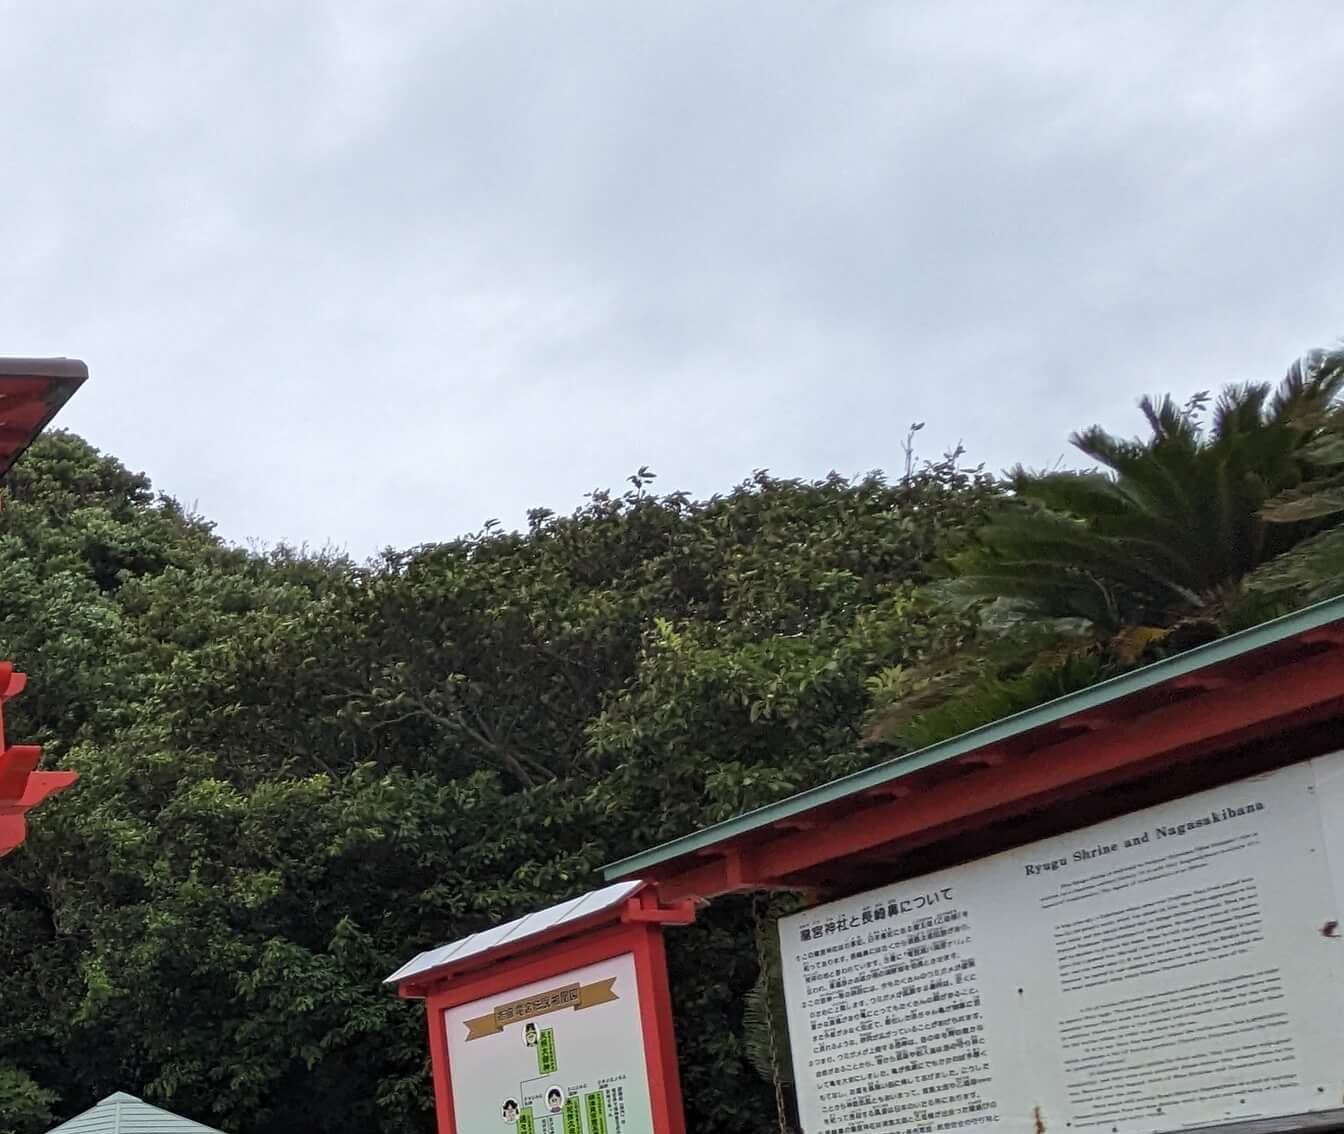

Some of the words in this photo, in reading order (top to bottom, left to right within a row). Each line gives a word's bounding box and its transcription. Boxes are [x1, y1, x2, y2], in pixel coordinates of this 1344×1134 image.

[1025, 858, 1067, 877] Ryugu
[1072, 841, 1118, 862] Shrine
[1124, 832, 1150, 849] and
[1155, 801, 1265, 839] Nagasakibana
